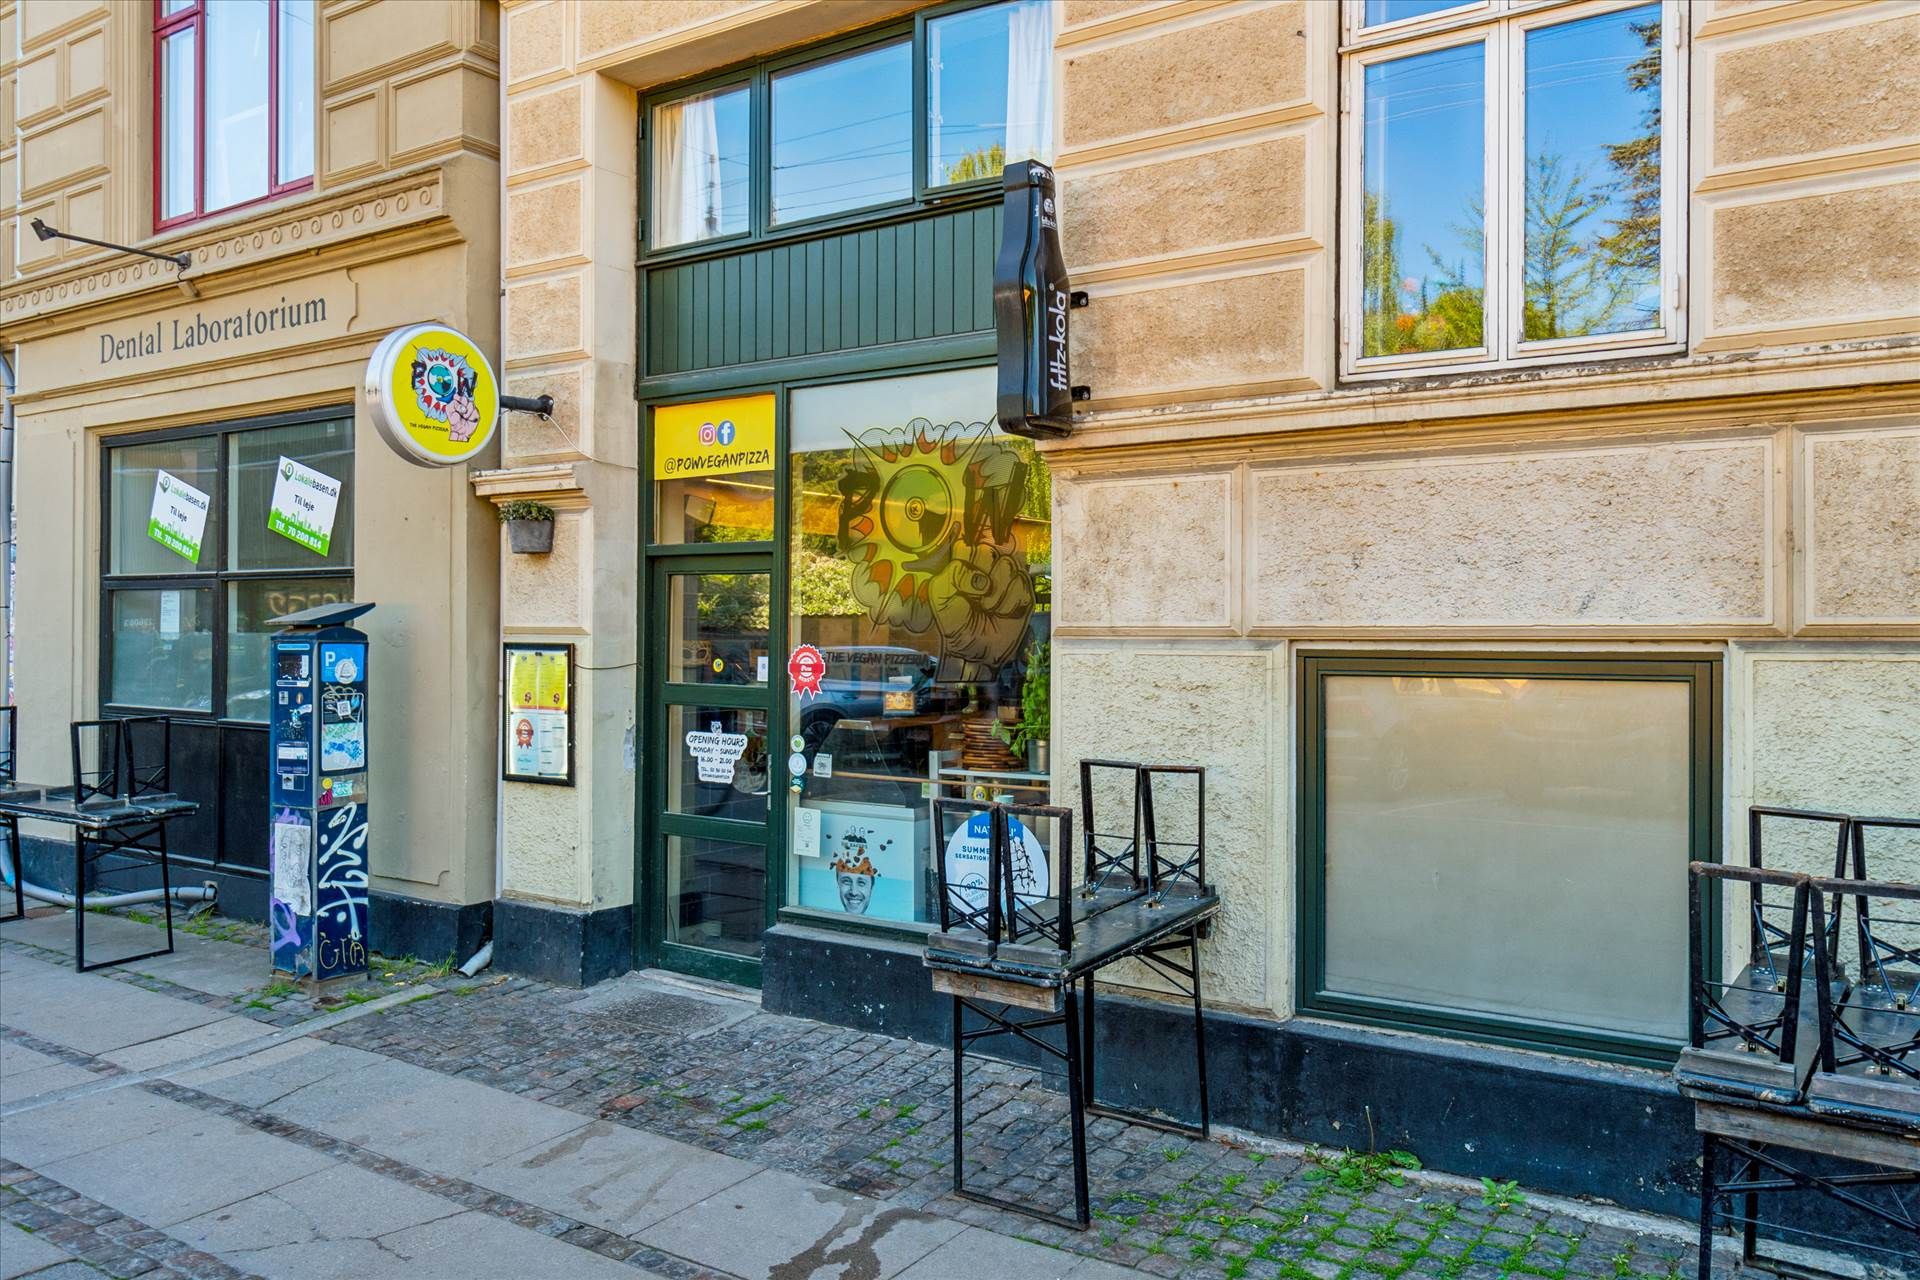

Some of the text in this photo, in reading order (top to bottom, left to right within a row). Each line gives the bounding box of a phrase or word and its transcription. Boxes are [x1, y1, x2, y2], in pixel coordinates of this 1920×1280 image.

[100, 297, 327, 364] Dental Laboratorium
[1049, 291, 1068, 391] fritz-kola
[664, 449, 770, 474] @POWVEGANPIZZA
[294, 494, 315, 511] Til leje
[325, 652, 336, 666] P
[826, 651, 845, 663] THE
[847, 651, 882, 665] VEGAN
[884, 653, 929, 666] PIZZERIA
[688, 735, 745, 747] OPENING HOURS
[962, 845, 990, 854] SUMME
